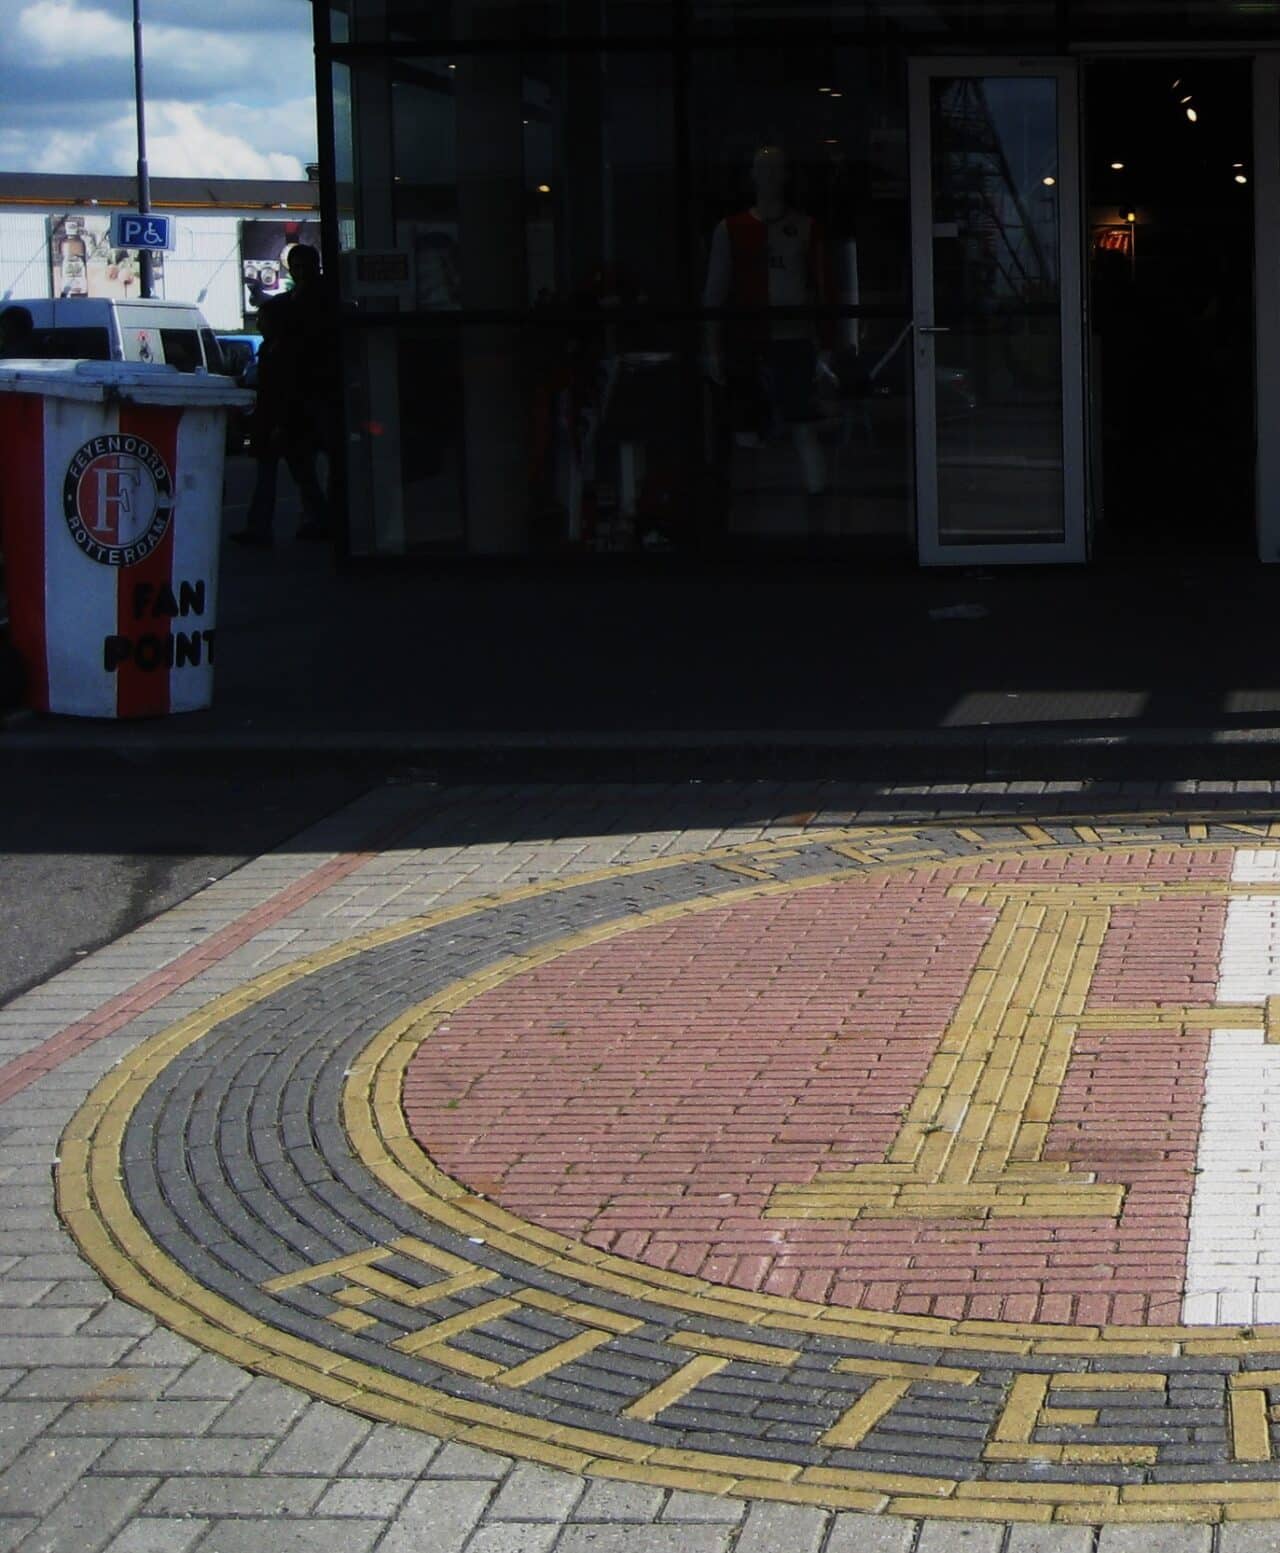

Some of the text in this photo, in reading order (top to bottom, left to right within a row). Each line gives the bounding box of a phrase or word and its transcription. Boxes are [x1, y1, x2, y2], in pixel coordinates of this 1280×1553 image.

[124, 221, 140, 243] P
[69, 436, 168, 483] FEYENOORD
[68, 515, 168, 566] ROTTERDAM
[132, 579, 206, 618] FAN
